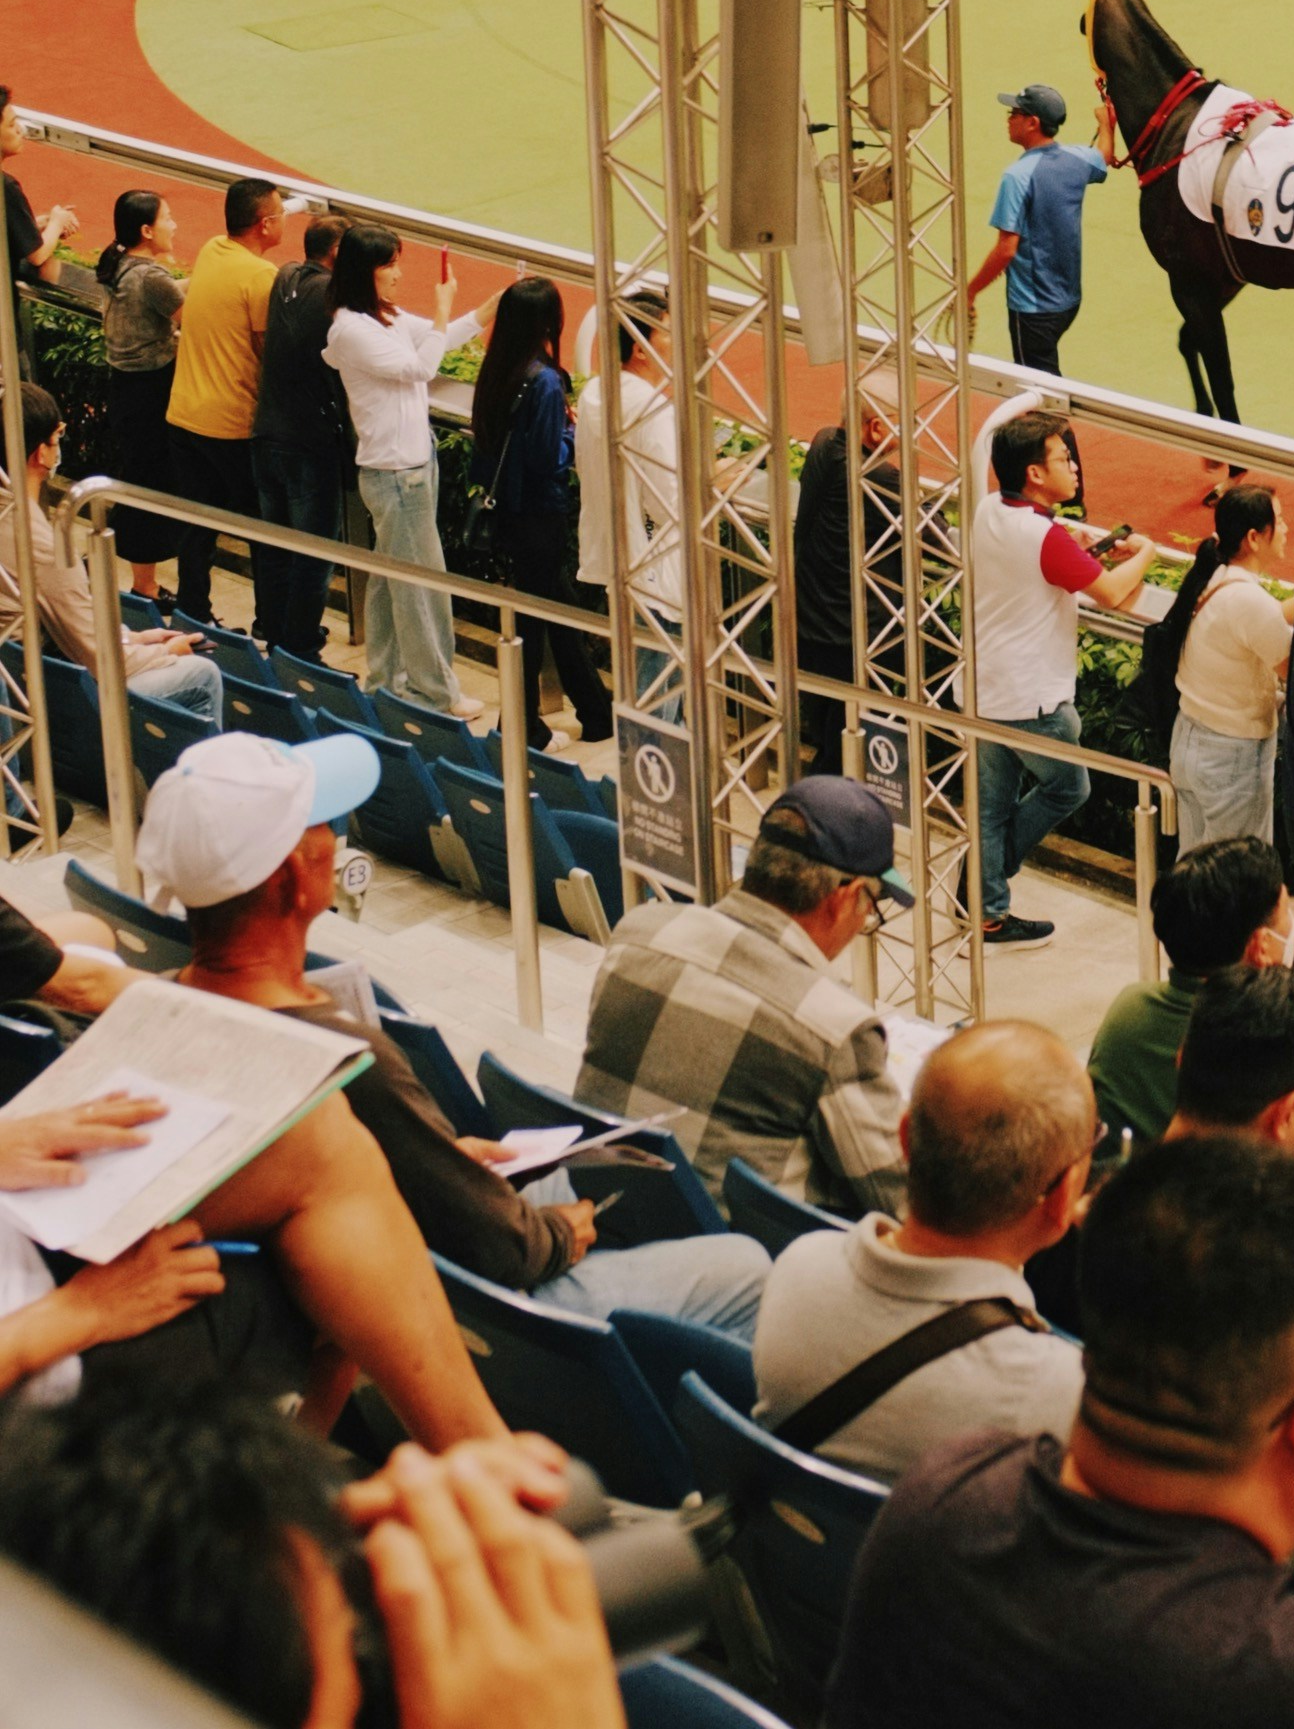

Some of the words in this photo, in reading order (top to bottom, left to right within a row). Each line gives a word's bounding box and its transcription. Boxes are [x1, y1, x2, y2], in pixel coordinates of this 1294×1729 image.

[633, 827, 645, 839] ON
[645, 832, 684, 857] STAIRCASE
[634, 816, 646, 828] NO
[646, 820, 682, 843] STANDING
